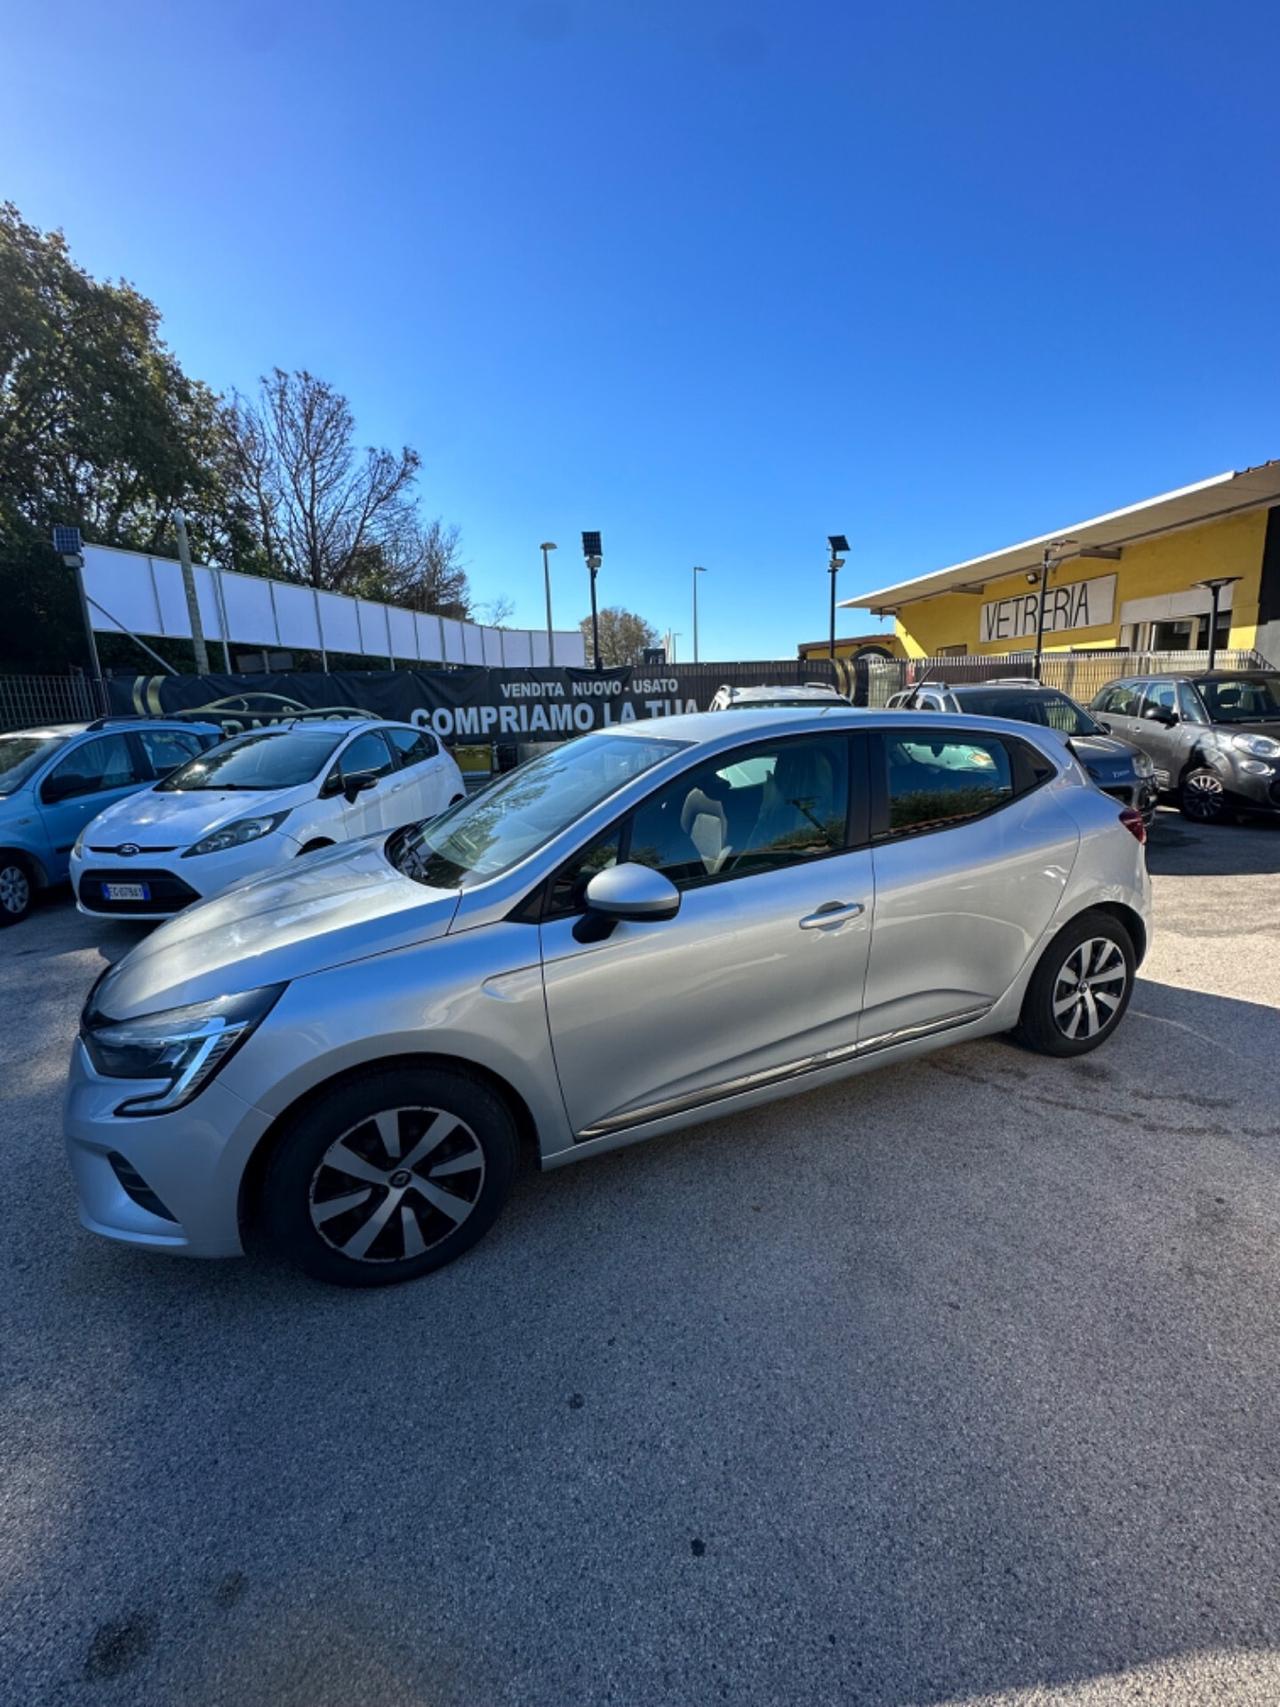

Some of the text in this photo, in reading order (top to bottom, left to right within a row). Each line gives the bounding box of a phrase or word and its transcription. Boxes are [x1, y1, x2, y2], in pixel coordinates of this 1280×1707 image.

[986, 582, 1089, 641] VETRERIA
[500, 681, 565, 698] VENDITA
[572, 681, 622, 696] NUOVO
[632, 678, 678, 694] USATO
[410, 702, 595, 736] COMPRIAMO
[603, 701, 637, 728] LA
